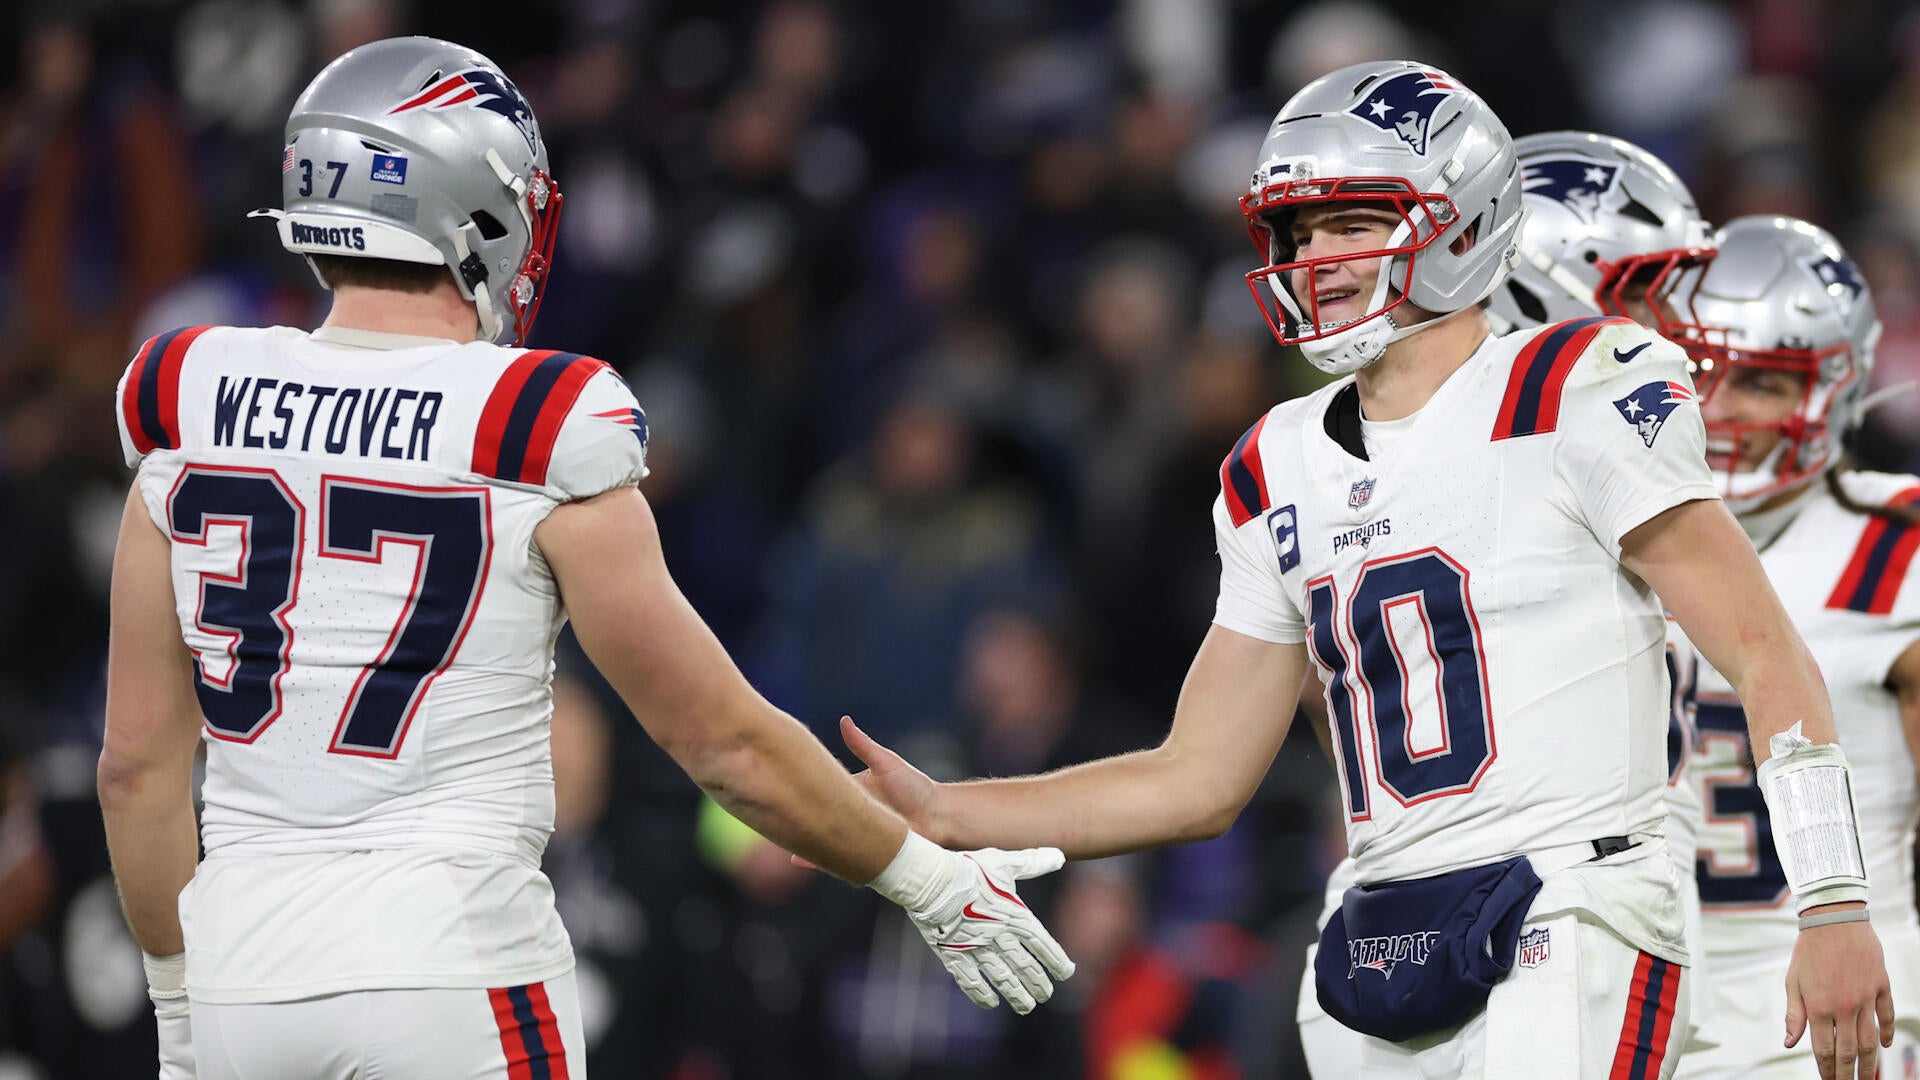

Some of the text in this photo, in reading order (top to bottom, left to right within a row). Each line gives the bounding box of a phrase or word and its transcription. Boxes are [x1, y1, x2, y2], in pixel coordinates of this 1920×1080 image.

[299, 159, 349, 199] 37
[291, 221, 365, 251] PATRIOTS
[214, 376, 443, 462] WESTOVER
[1351, 490, 1369, 505] NFL
[1270, 511, 1295, 558] C
[1333, 519, 1391, 555] PATRIOTS
[166, 462, 493, 760] 37
[1306, 546, 1498, 823] 10
[1522, 945, 1547, 965] NFL
